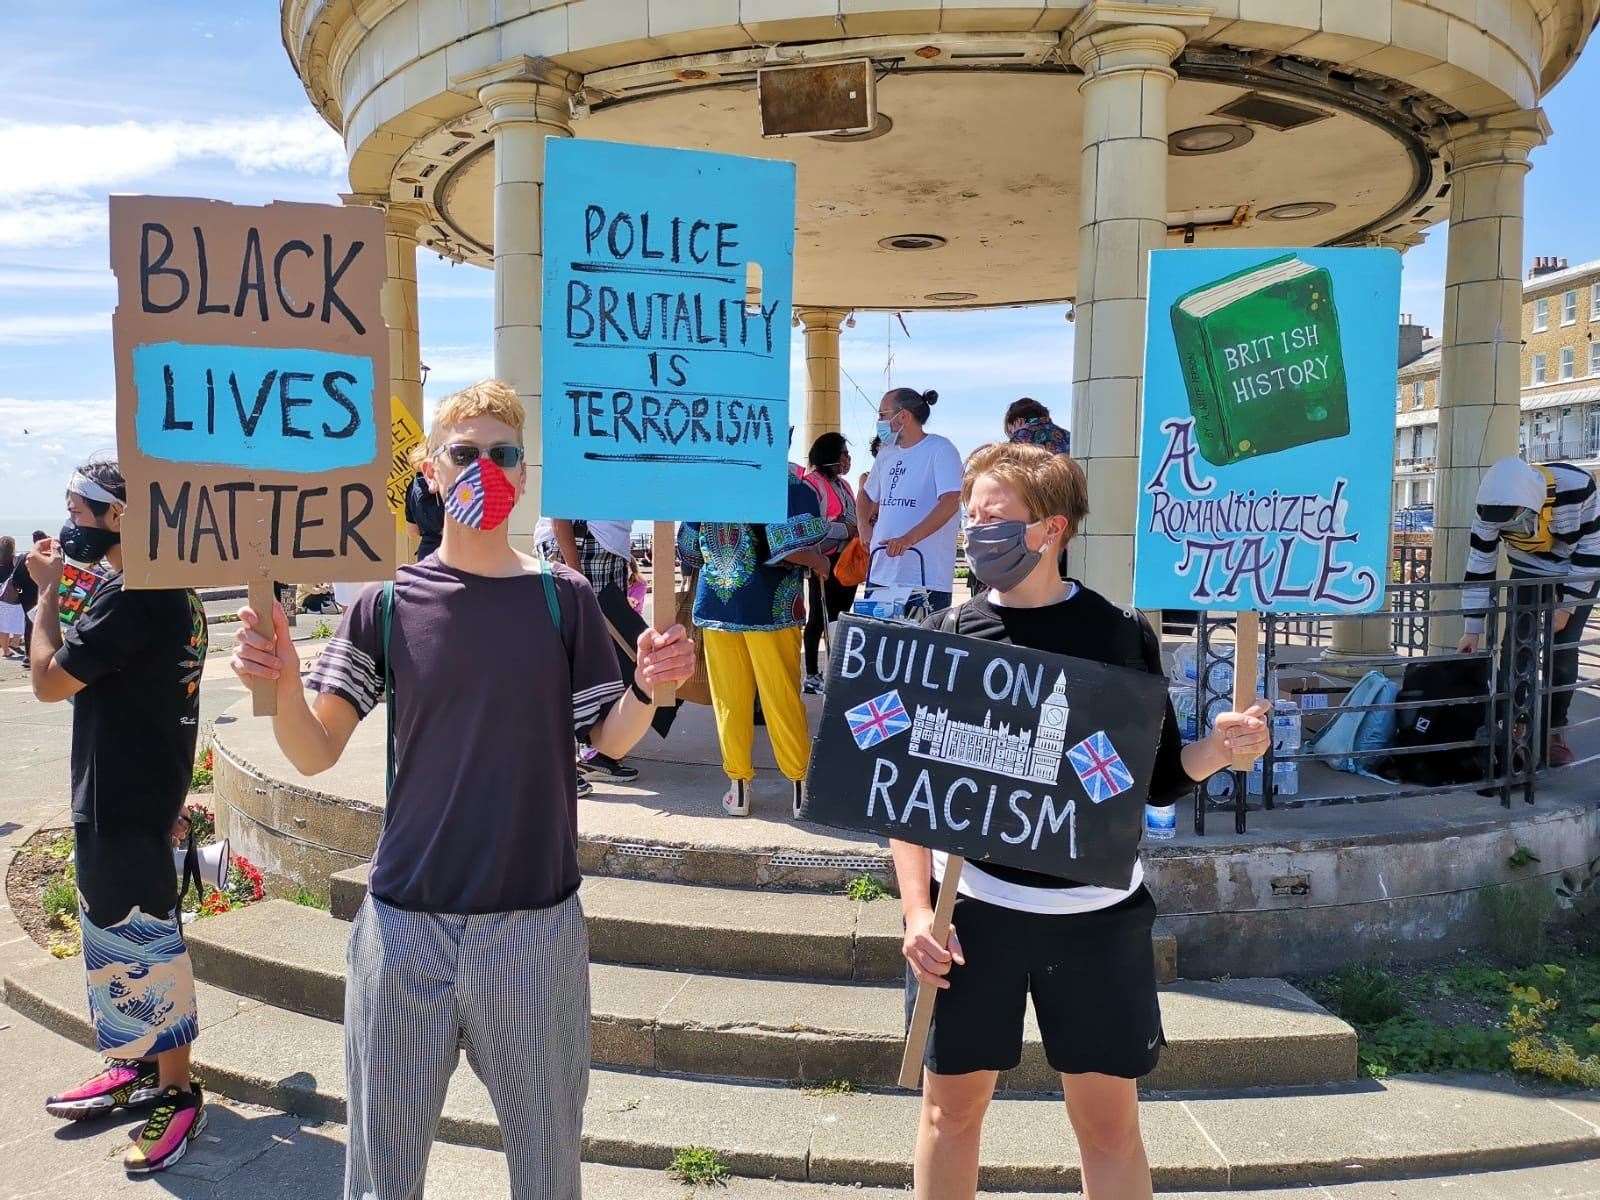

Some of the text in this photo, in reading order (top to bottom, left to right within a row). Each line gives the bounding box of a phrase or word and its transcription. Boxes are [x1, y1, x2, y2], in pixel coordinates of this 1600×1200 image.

[585, 204, 742, 268] POLICE
[139, 222, 366, 335] BLACK
[566, 279, 780, 353] BRUTALITY
[162, 364, 361, 439] LIVES
[648, 351, 690, 387] IS
[1231, 355, 1329, 404] HISTORY
[564, 390, 775, 448] TERRORISM
[1148, 421, 1212, 491] A
[149, 481, 383, 563] MATTER
[1178, 533, 1376, 606] TALE
[841, 626, 1044, 708] BUILT ON
[866, 758, 1077, 859] RACISM
